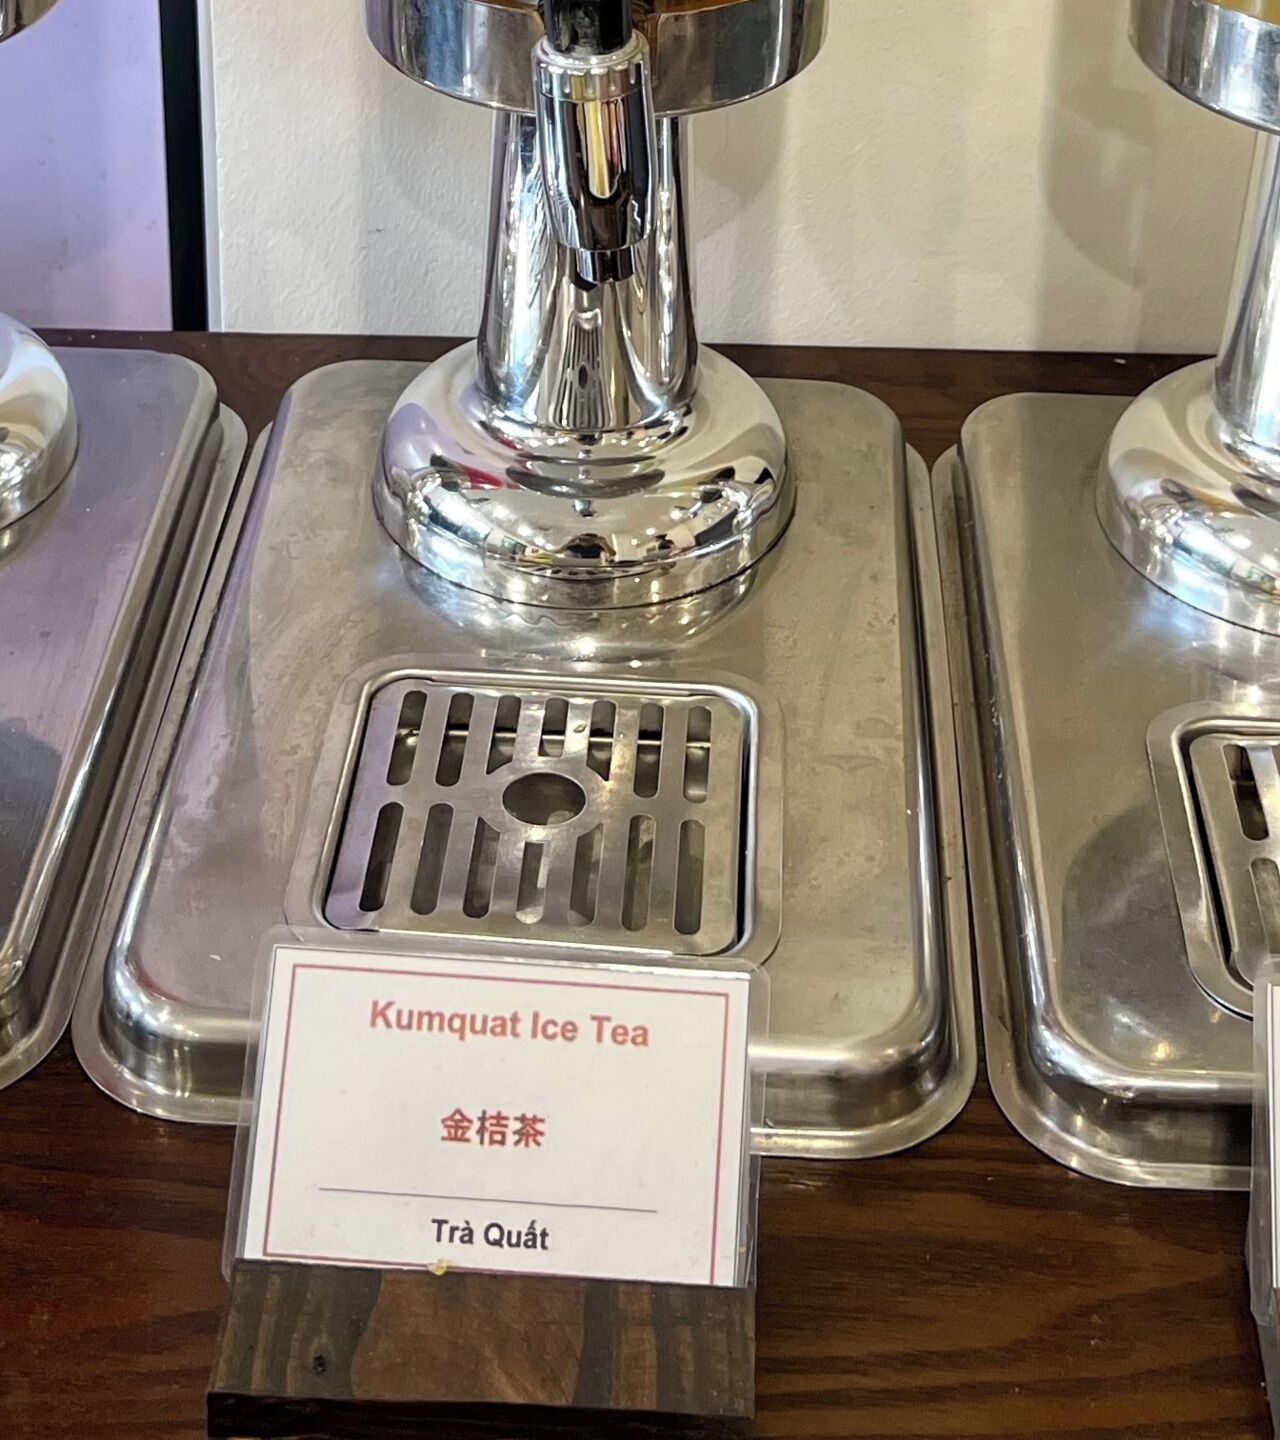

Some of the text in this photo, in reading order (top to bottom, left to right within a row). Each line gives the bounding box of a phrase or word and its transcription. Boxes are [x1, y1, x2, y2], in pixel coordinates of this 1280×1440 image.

[369, 999, 649, 1048] Kumquat Ice Tea
[440, 1107, 546, 1149] 金桔茶
[430, 1217, 550, 1251] Trà Quất
